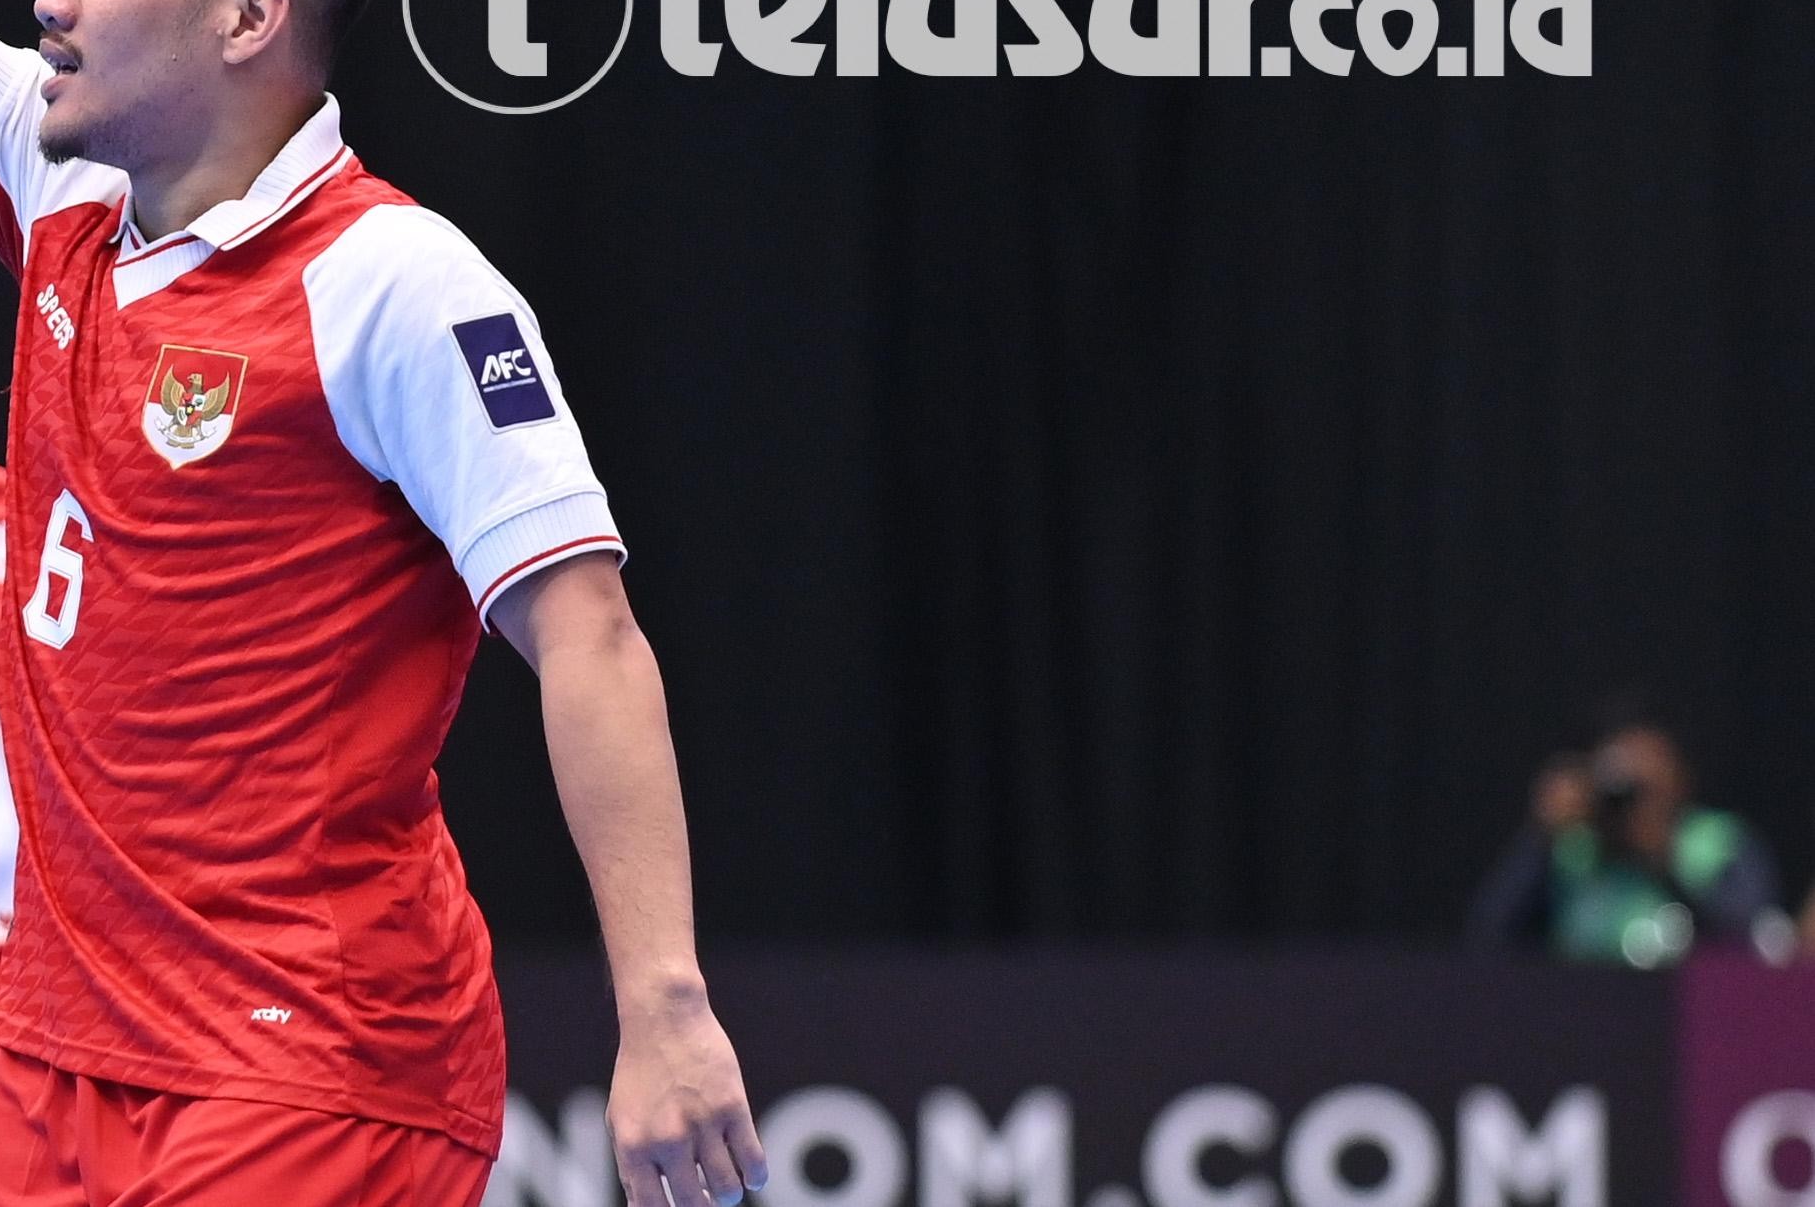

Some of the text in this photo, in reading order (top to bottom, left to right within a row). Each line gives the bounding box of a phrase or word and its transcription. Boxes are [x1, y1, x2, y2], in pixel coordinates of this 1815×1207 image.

[36, 282, 75, 350] SPECS
[480, 348, 532, 385] AFC
[22, 488, 95, 650] 6
[490, 1084, 1608, 1207] NOM.COM
